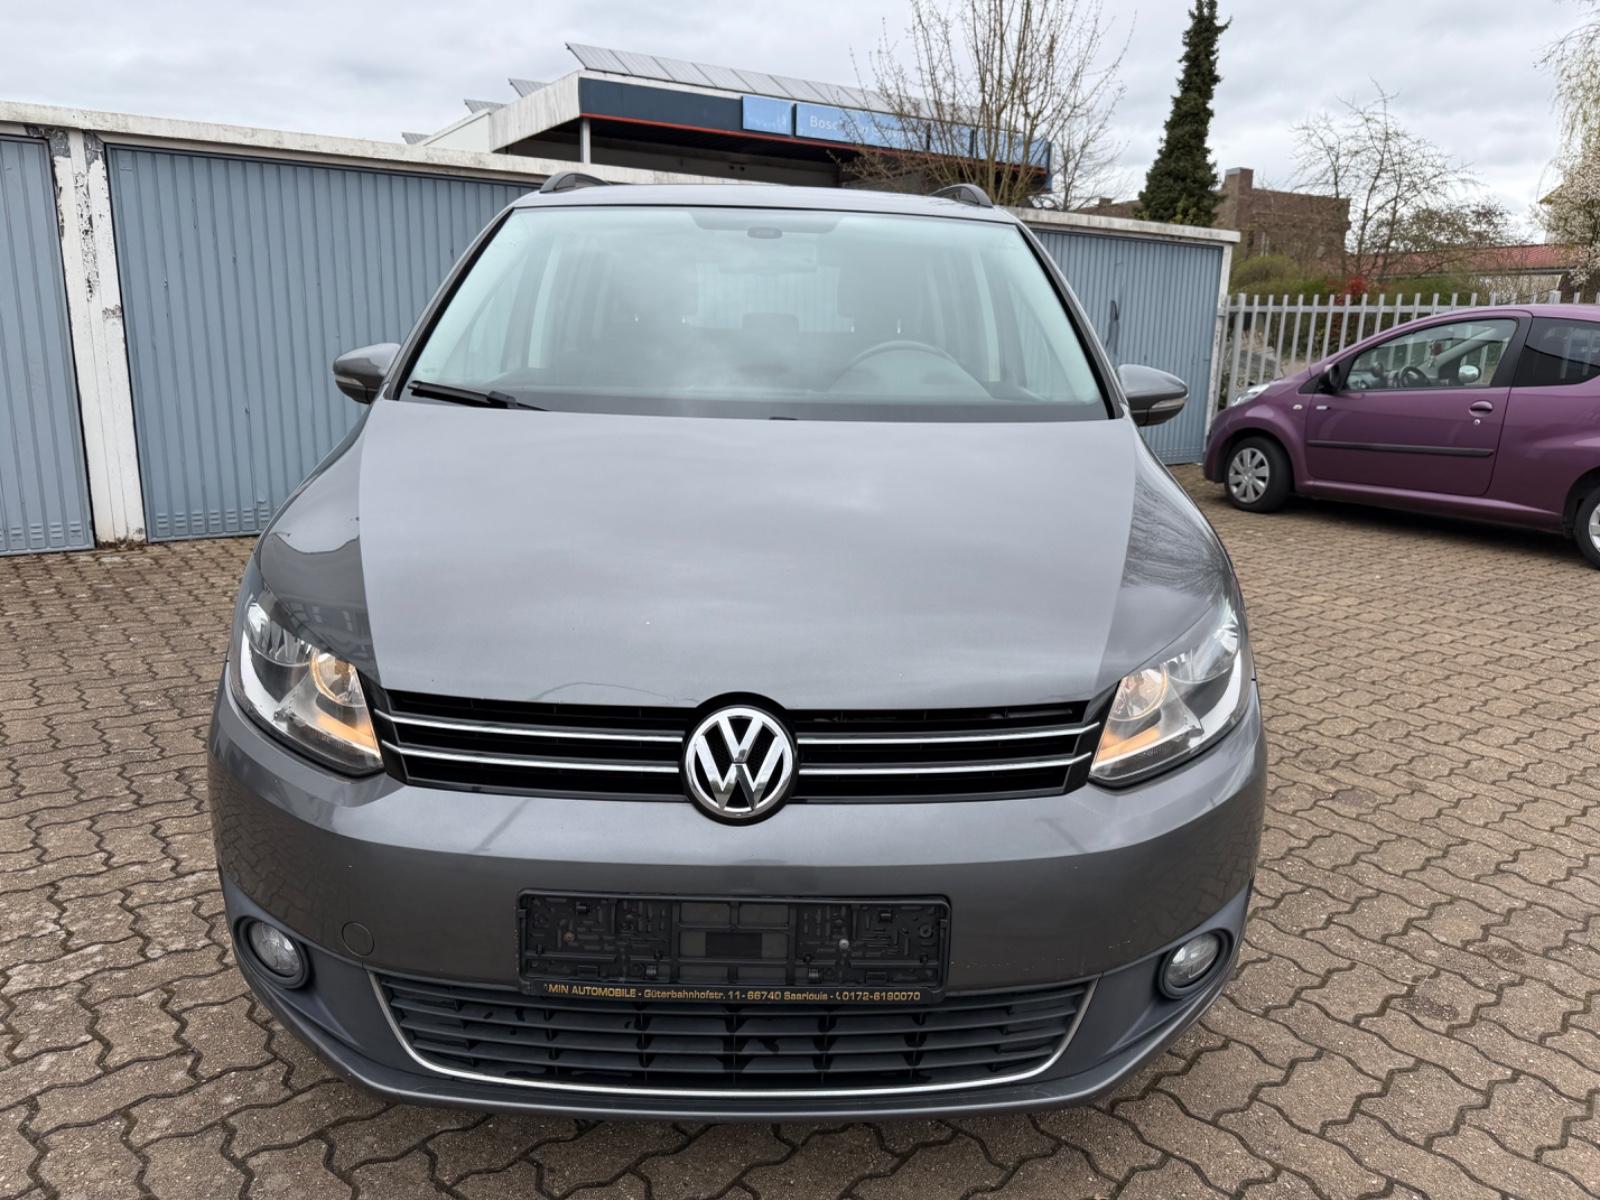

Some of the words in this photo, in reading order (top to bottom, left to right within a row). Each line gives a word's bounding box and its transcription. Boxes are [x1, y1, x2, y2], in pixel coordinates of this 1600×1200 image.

[688, 708, 790, 815] VW
[544, 983, 569, 994] MIN
[571, 985, 637, 998] AUTOMOBILE
[643, 988, 726, 1000] Güterbahnhofstr.
[783, 991, 829, 1001] Saarlouis
